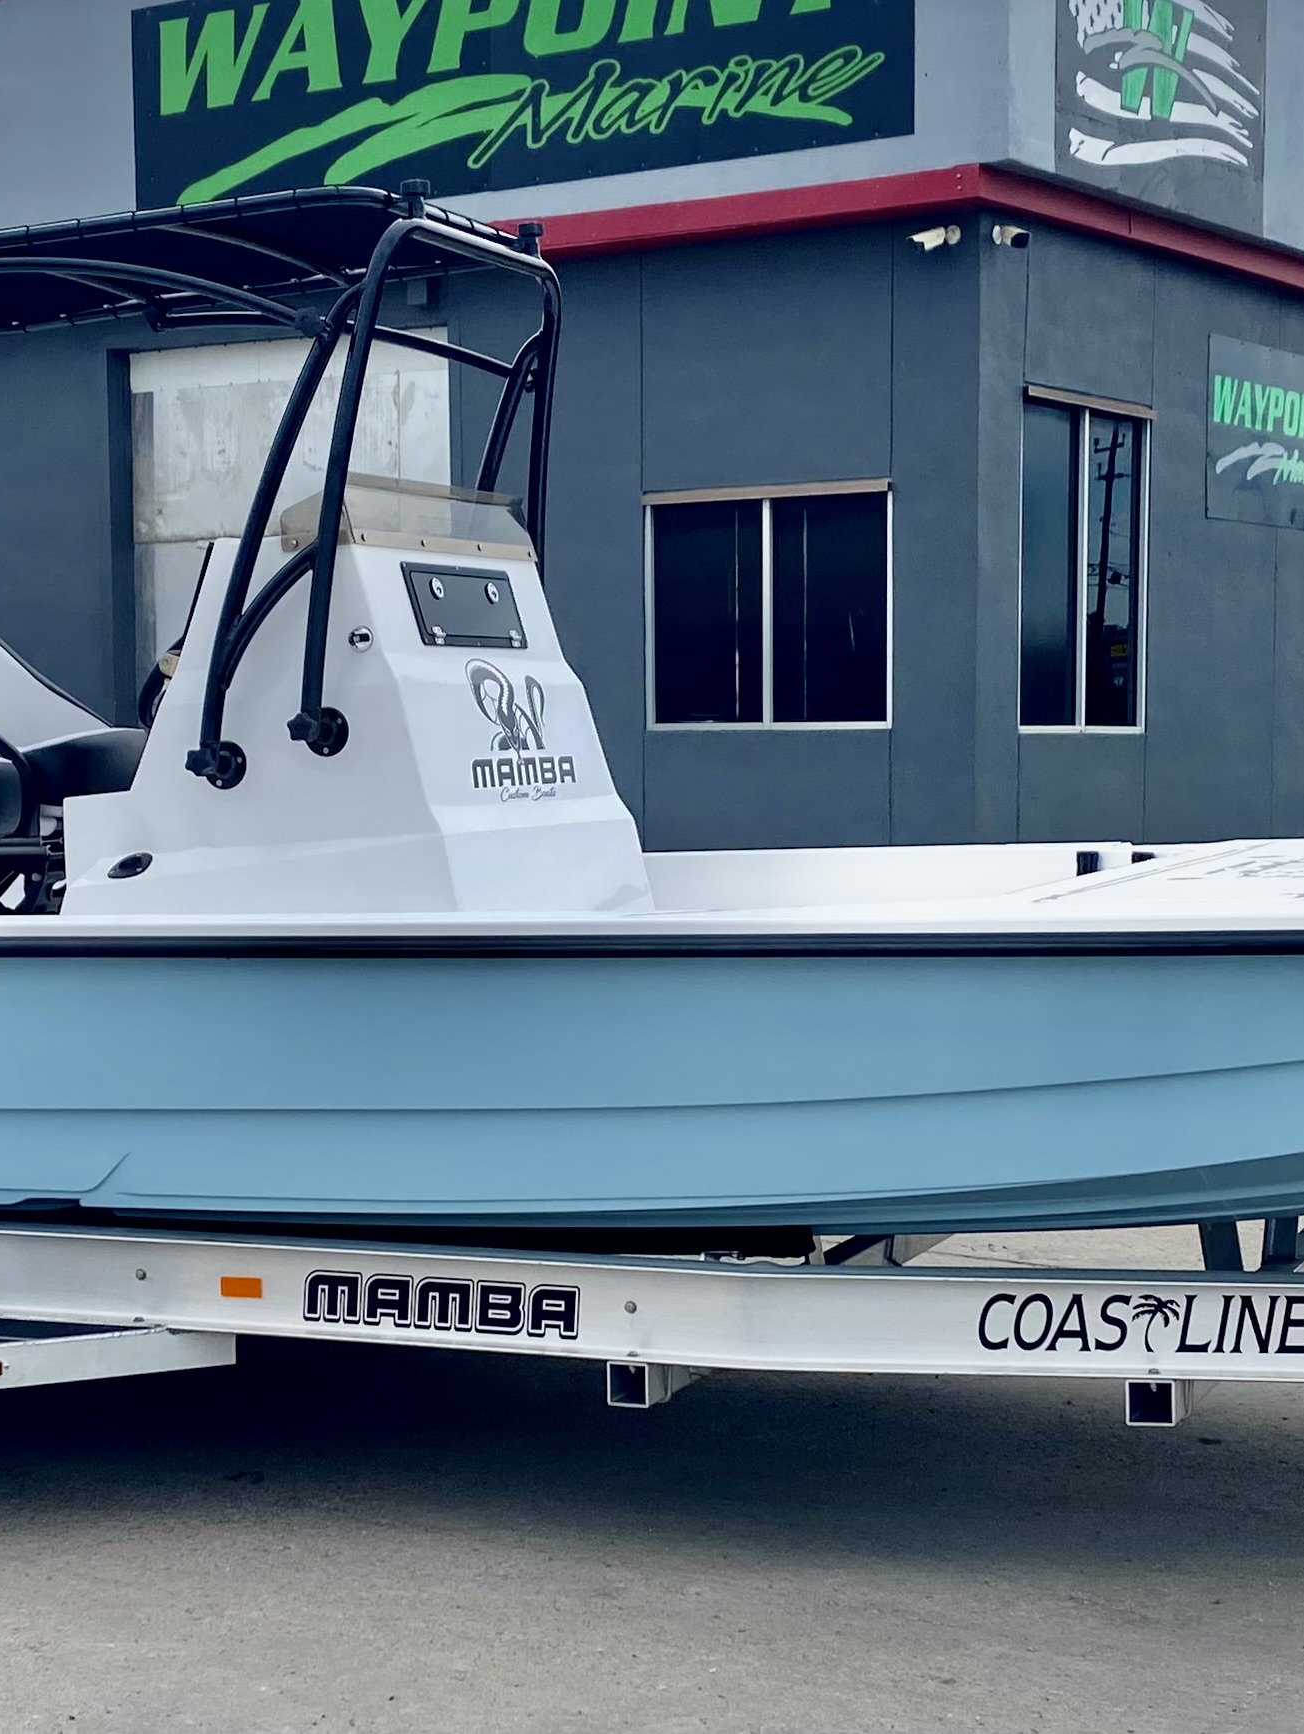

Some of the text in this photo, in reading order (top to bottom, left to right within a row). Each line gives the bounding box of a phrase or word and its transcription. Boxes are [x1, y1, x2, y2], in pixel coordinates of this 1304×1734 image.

[158, 0, 832, 116] WAYPO
[467, 45, 885, 168] Marine
[472, 755, 576, 788] MAMBA
[500, 785, 556, 802] Custom Boats
[303, 1269, 581, 1340] MAMBA
